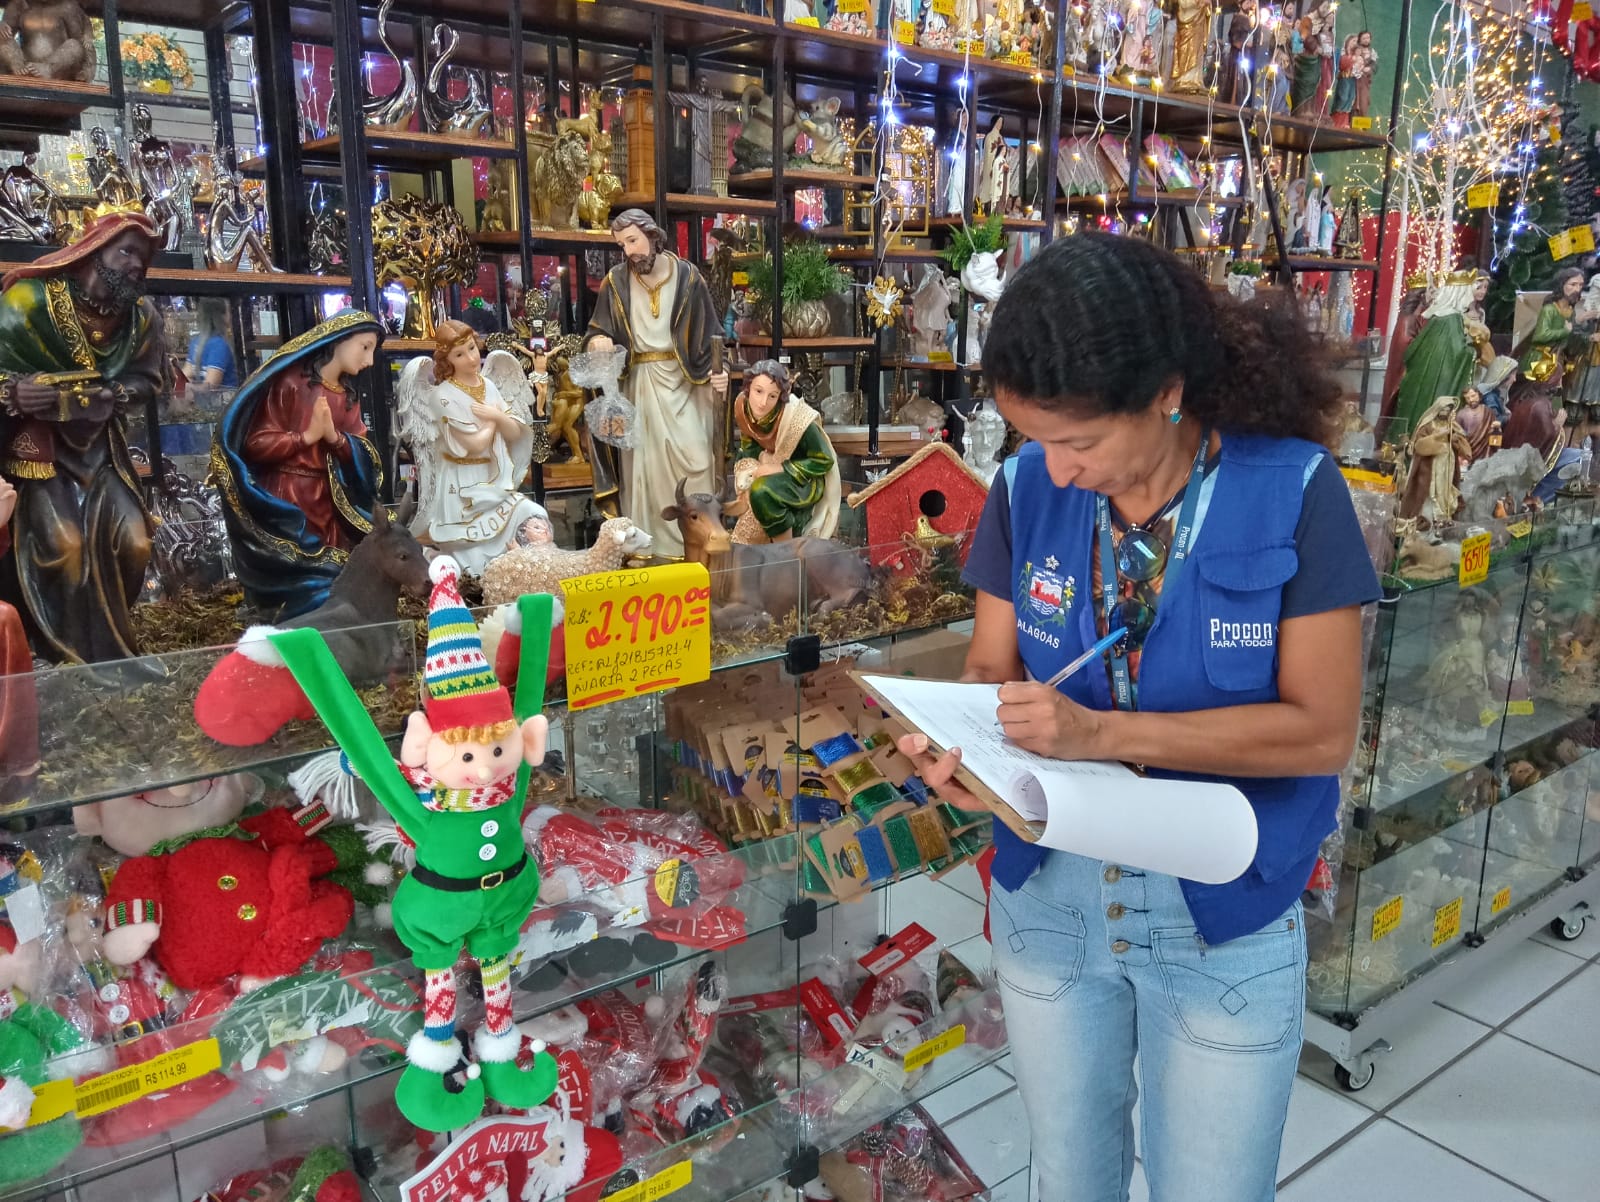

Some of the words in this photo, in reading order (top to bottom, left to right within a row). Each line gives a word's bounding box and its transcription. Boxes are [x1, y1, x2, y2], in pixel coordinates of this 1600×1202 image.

[561, 571, 650, 597] PRESEPIO
[1017, 618, 1060, 649] ALAGOAS
[1210, 618, 1273, 640] Procon
[1210, 640, 1238, 648] PARA
[1240, 640, 1273, 648] TODOS
[629, 668, 638, 682] 2
[145, 1073, 157, 1087] R$
[158, 1062, 188, 1083] 114,99
[416, 1142, 479, 1202] FELIZ
[485, 1130, 539, 1156] NATAL
